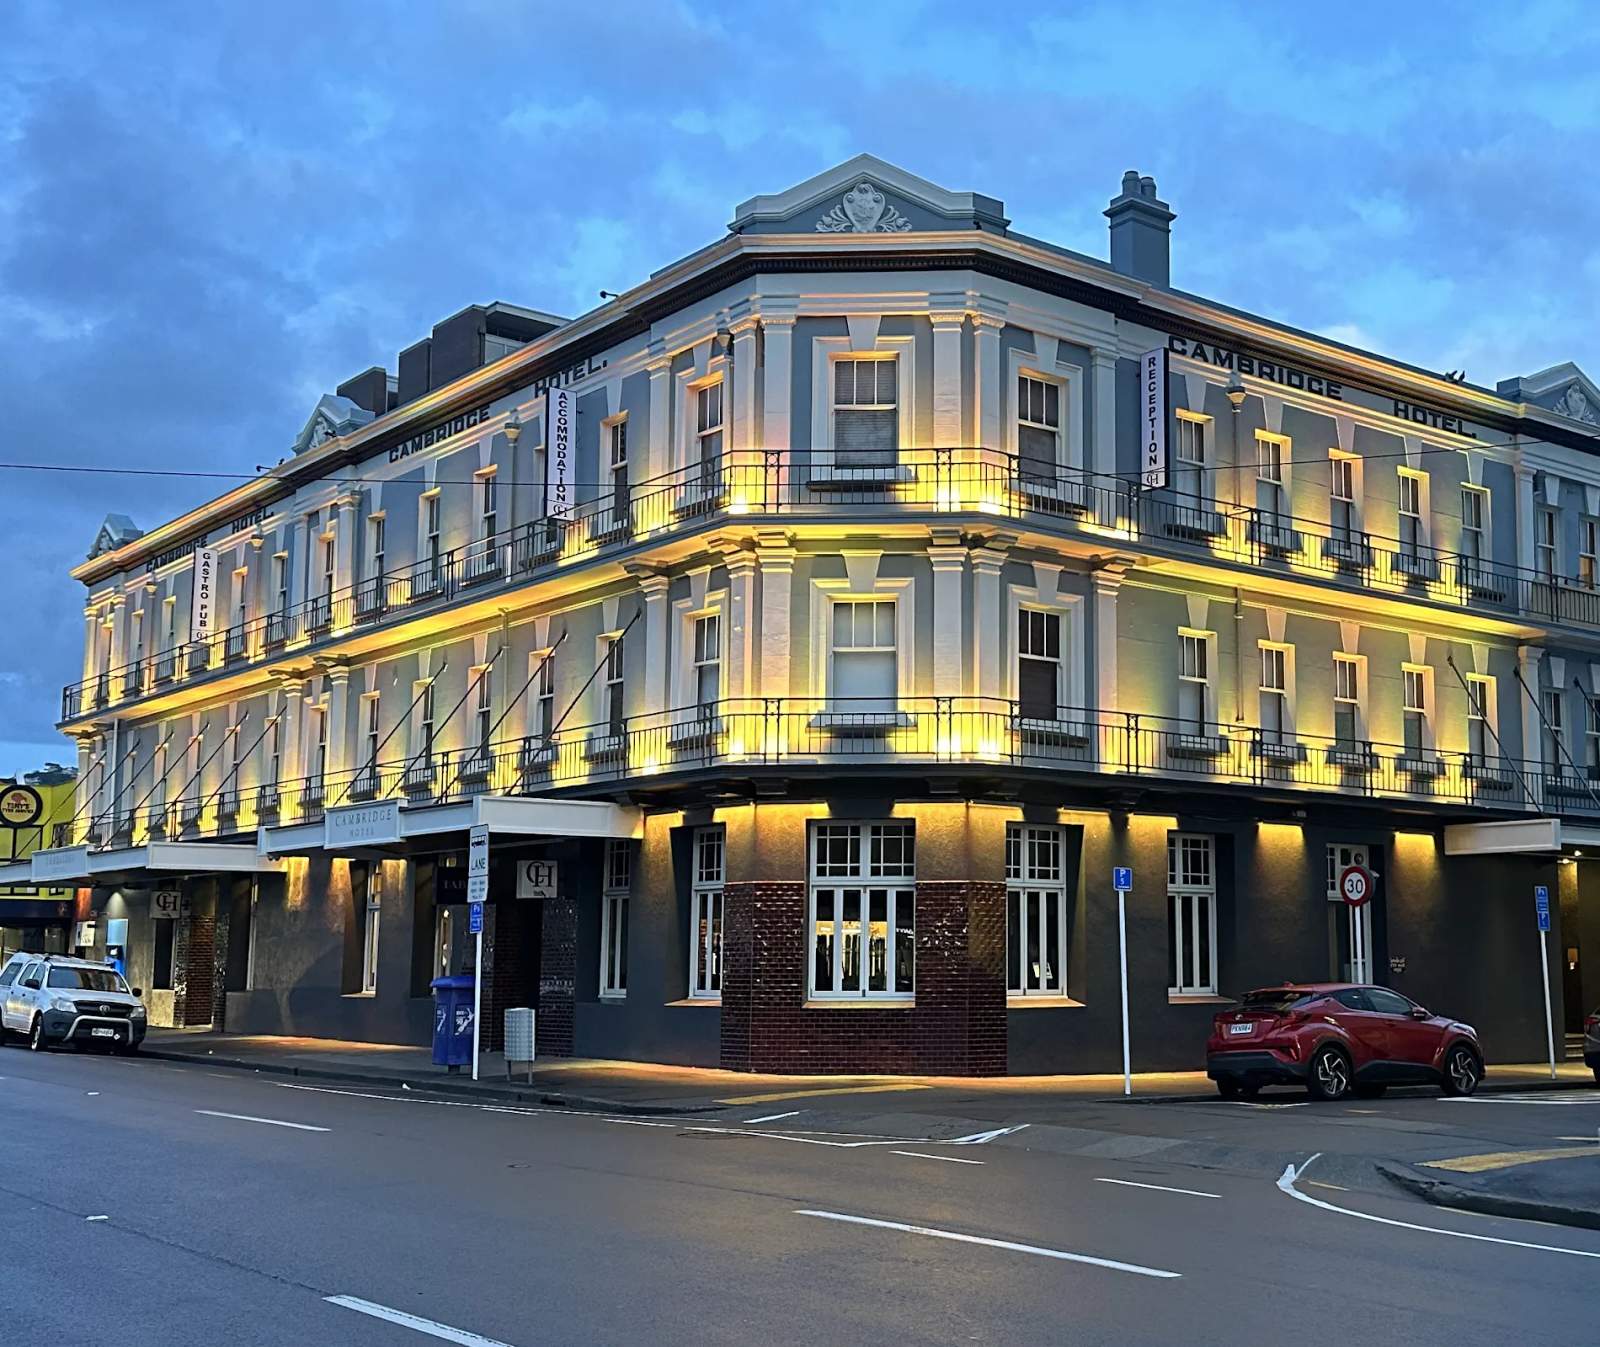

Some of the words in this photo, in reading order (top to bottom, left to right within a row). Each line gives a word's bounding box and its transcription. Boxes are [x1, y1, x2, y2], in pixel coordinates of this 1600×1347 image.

[1168, 335, 1343, 400] CAMBRIDGE
[388, 404, 490, 463] CAMBRIDGE
[1148, 356, 1158, 466] RECEPTION
[557, 391, 568, 502] ACCOMMODATION
[201, 552, 211, 599] GASTRO
[199, 604, 208, 627] PUB
[335, 809, 392, 827] CAMBRIDGE
[471, 857, 486, 871] LANE
[1346, 878, 1364, 894] 30
